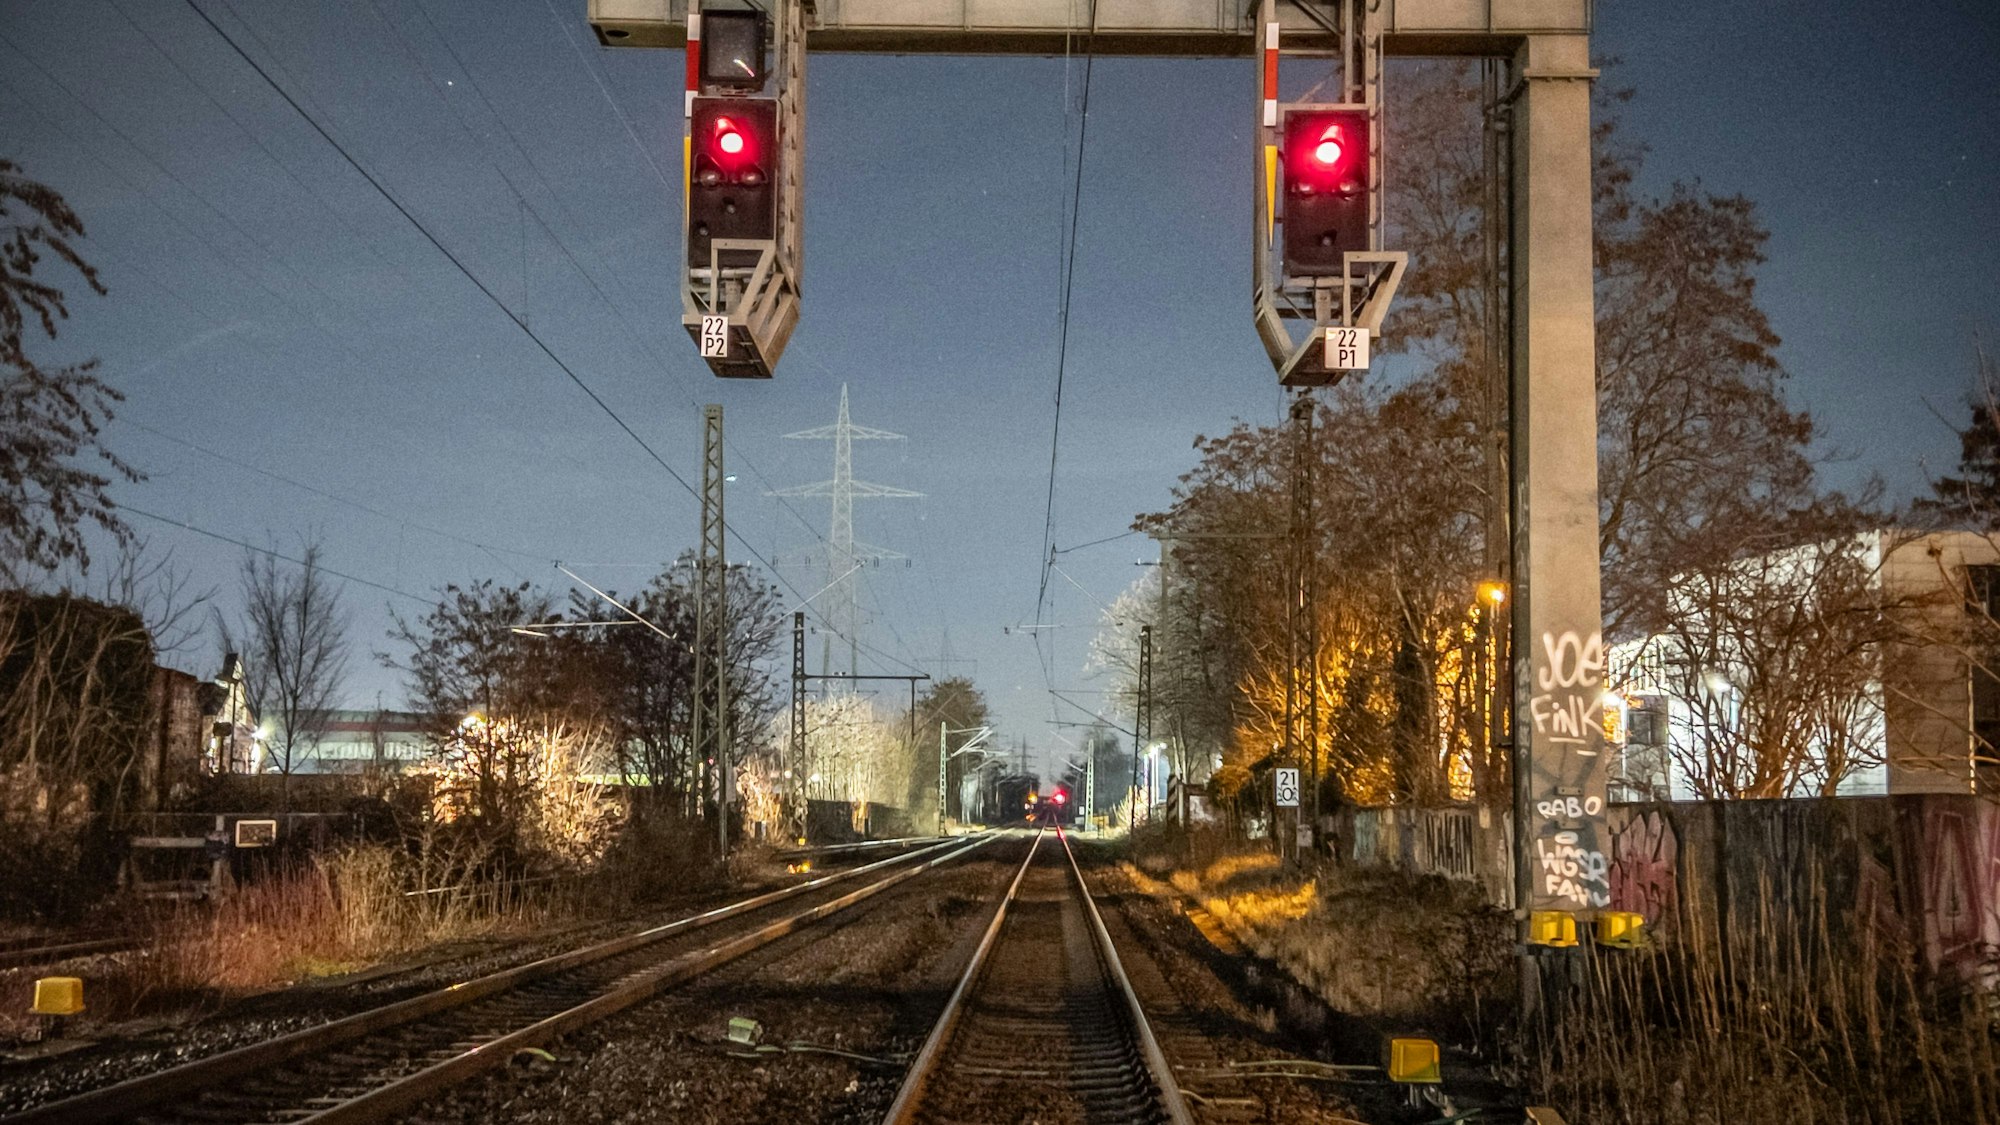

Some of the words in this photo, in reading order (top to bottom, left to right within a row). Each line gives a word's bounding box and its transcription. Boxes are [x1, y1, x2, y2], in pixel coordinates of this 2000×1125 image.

[705, 318, 723, 335] 22
[705, 338, 724, 355] P2
[1338, 330, 1357, 347] 22
[1339, 350, 1355, 367] P1
[1280, 771, 1295, 785] 21
[1537, 795, 1602, 819] RABO
